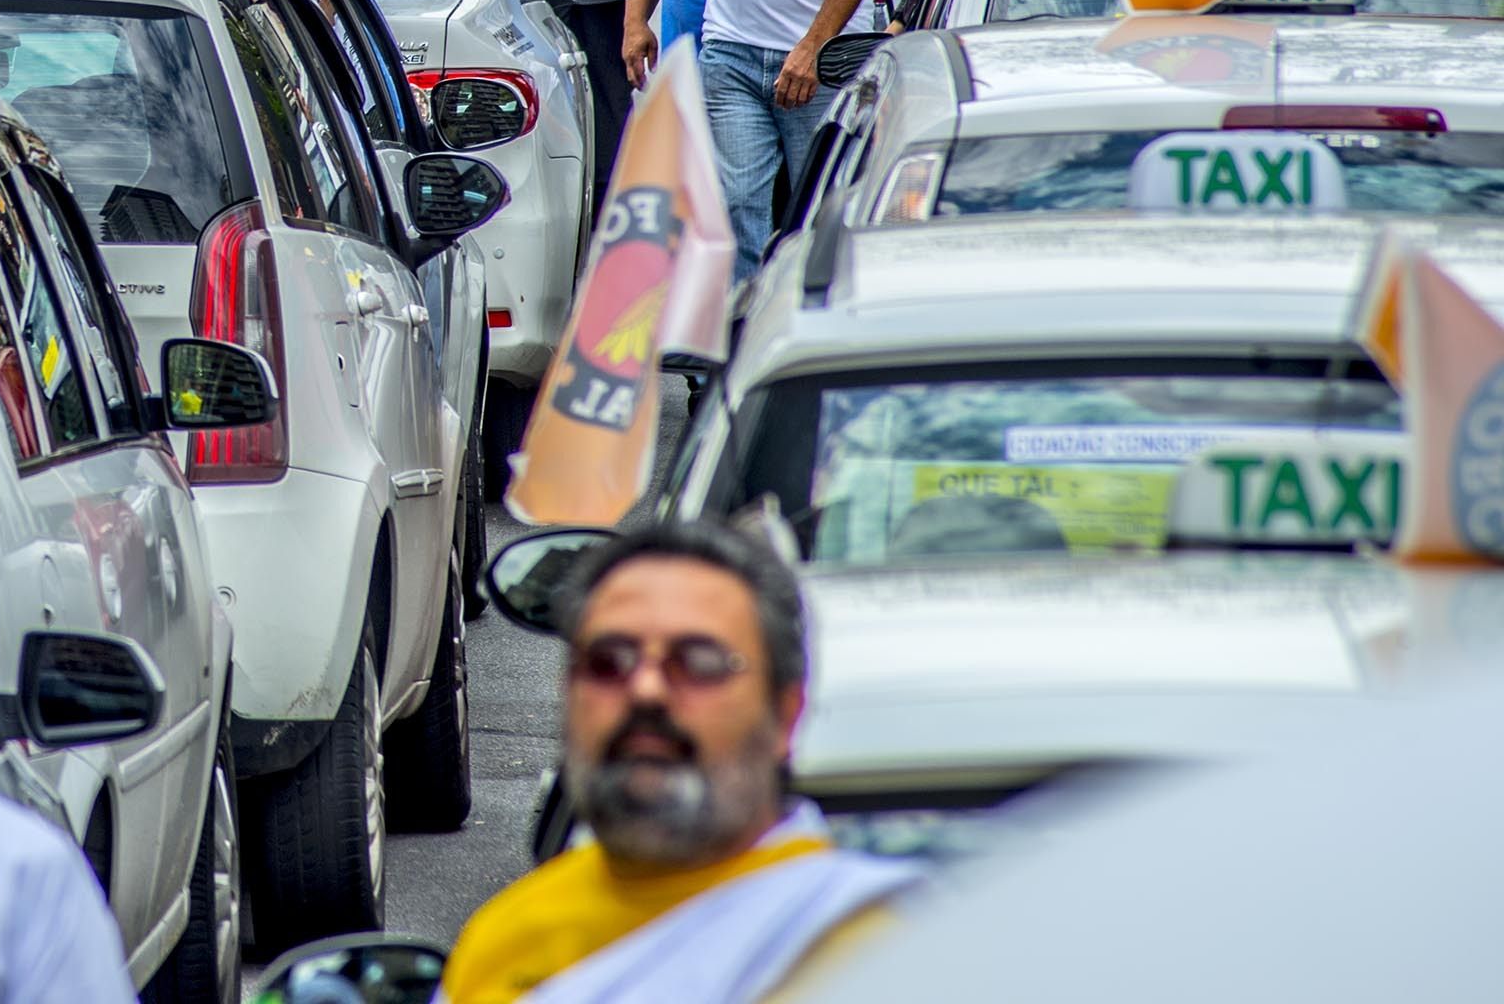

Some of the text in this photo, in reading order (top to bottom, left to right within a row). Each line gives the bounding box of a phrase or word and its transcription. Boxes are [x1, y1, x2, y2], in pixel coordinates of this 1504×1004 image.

[1163, 148, 1313, 204] TAXI
[116, 283, 165, 295] CTIVE
[1210, 455, 1400, 533] TAXI
